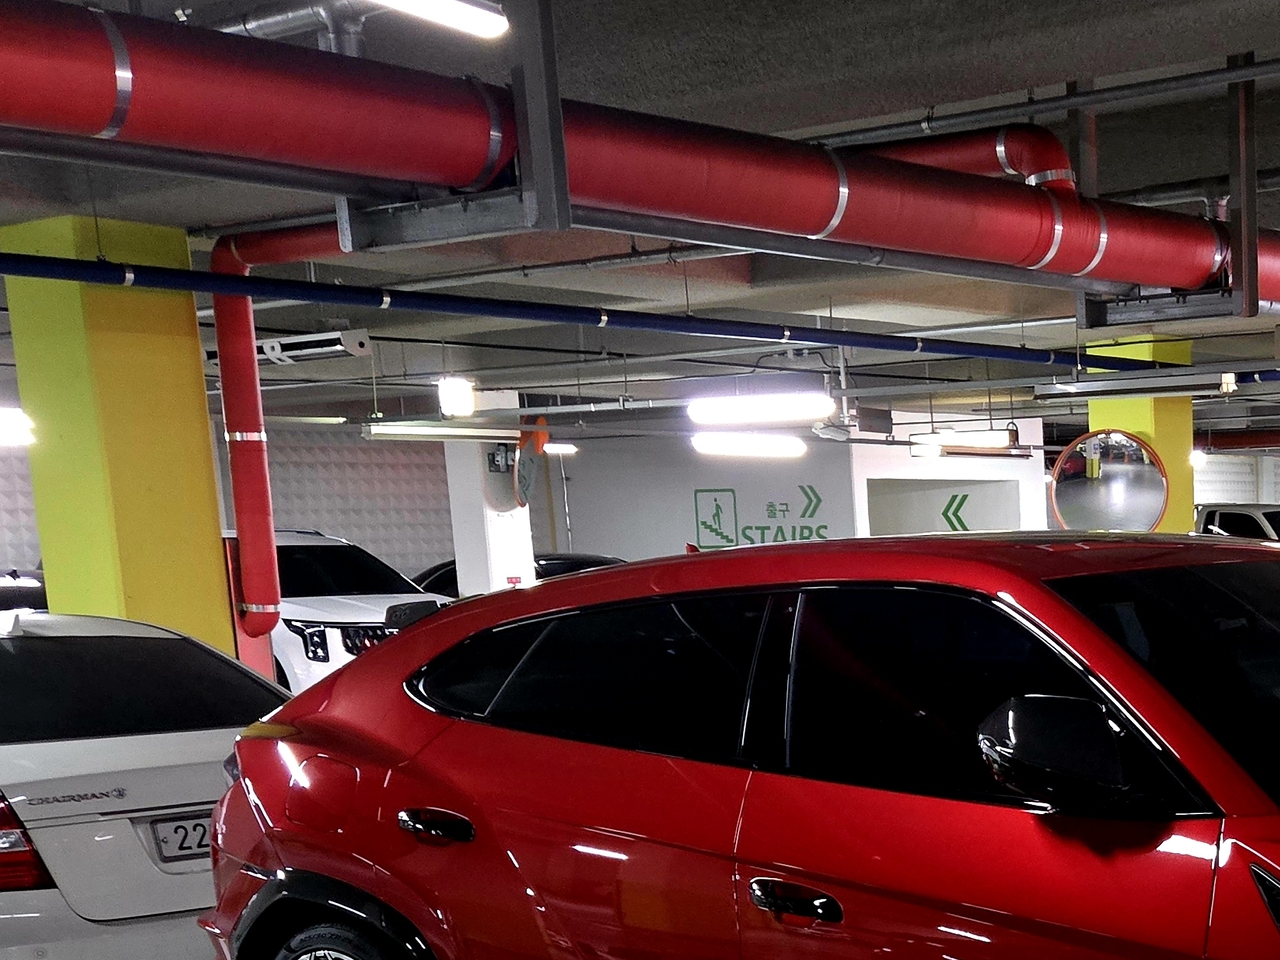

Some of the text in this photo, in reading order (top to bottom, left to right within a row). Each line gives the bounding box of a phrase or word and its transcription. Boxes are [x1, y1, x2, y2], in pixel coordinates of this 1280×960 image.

[766, 501, 790, 518] 출구
[741, 525, 828, 544] STAIRS
[27, 791, 110, 806] CHAIRMAN
